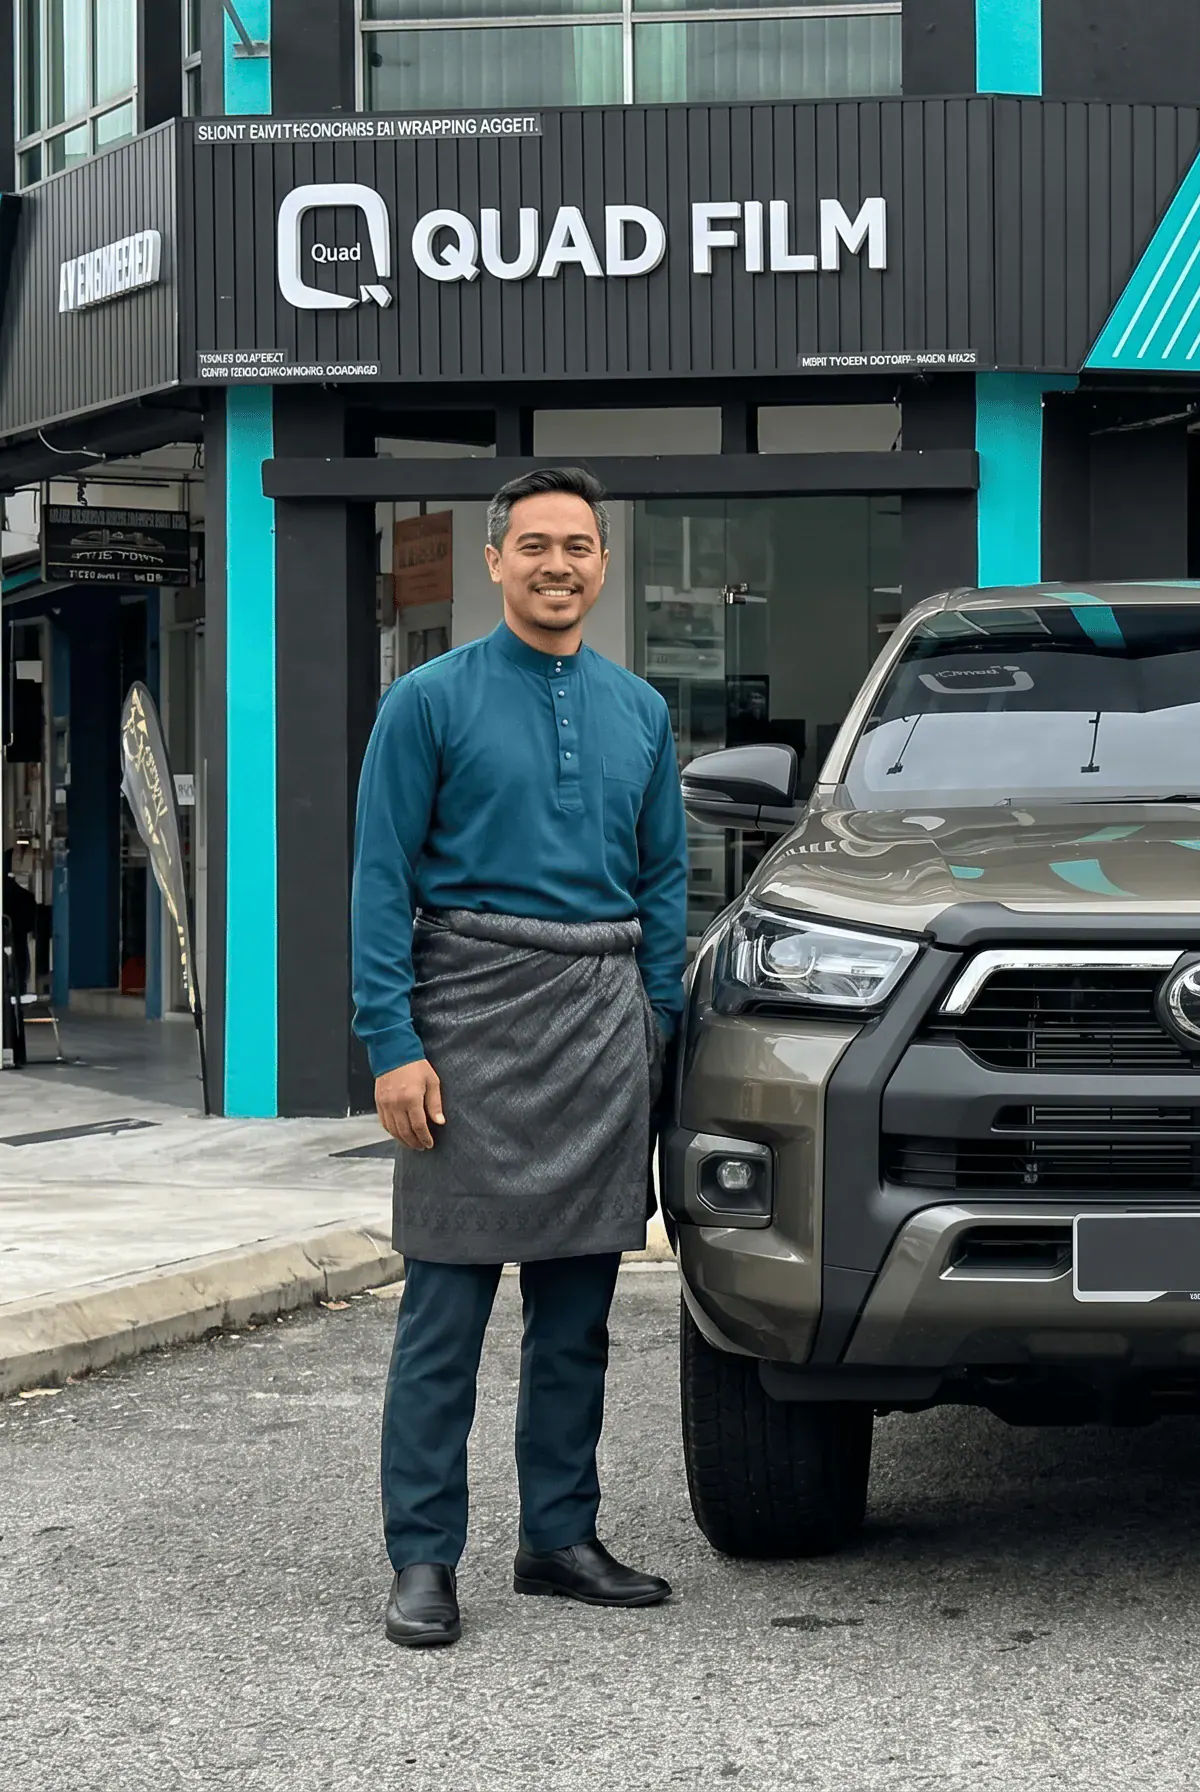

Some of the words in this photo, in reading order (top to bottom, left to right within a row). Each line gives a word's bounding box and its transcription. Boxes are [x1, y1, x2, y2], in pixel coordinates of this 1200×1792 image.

[398, 119, 477, 136] WRAPPING
[411, 205, 667, 283] QUAD
[692, 197, 887, 275] FILM
[311, 242, 361, 263] Quad
